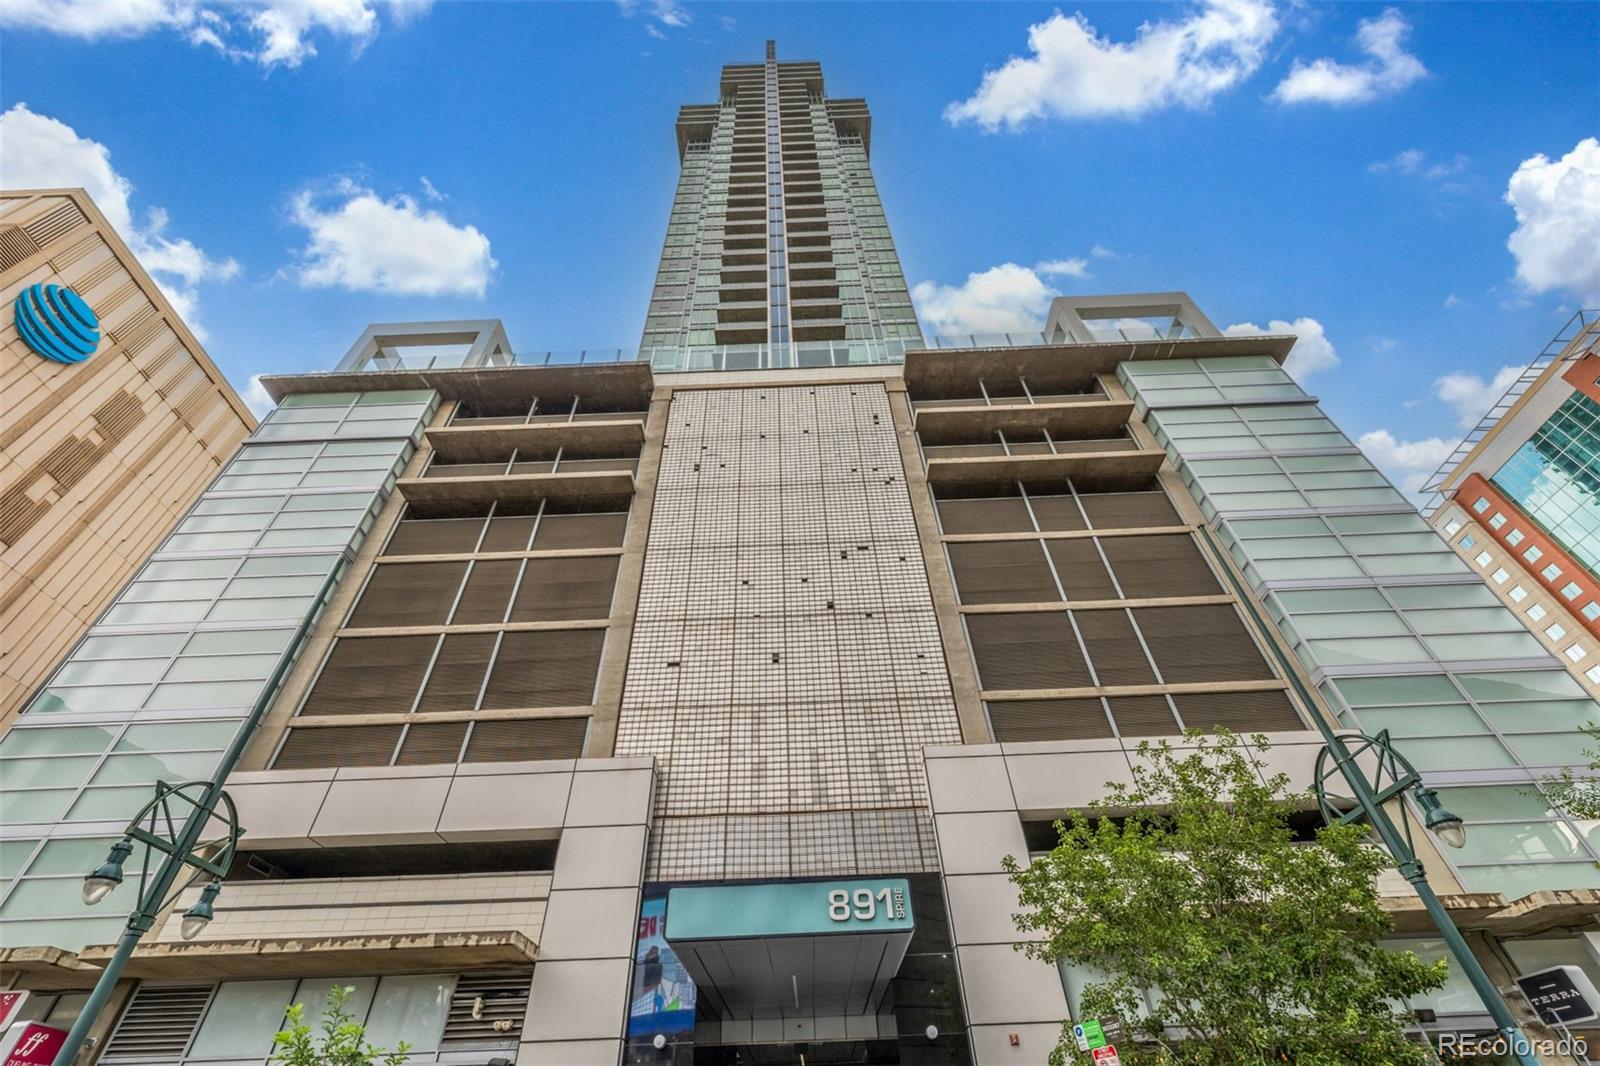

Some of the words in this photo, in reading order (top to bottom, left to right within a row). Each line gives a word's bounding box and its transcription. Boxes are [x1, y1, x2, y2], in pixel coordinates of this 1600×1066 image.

[828, 887, 894, 921] 891
[894, 887, 905, 919] SPIRE
[1531, 988, 1580, 1006] TERRA
